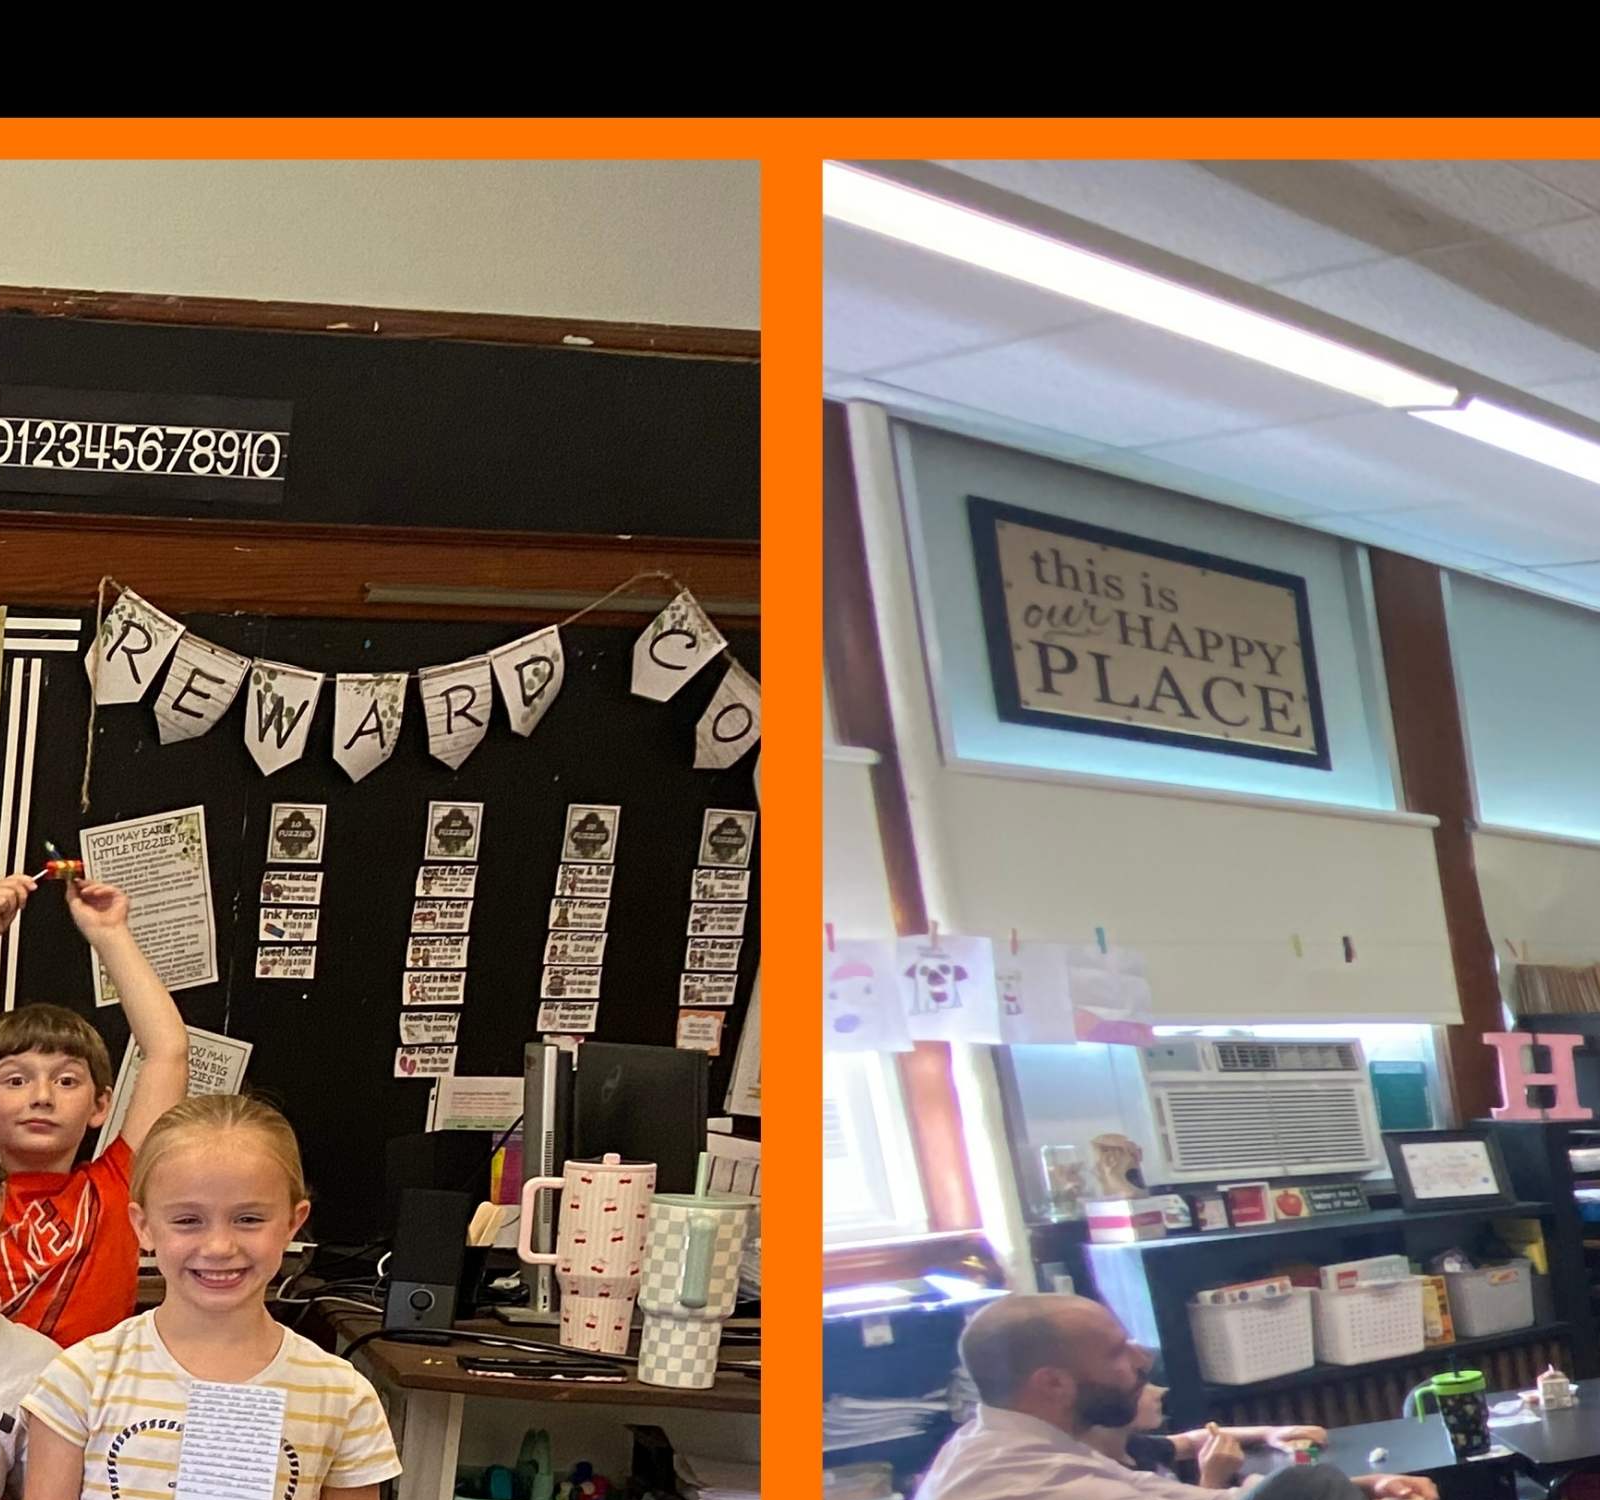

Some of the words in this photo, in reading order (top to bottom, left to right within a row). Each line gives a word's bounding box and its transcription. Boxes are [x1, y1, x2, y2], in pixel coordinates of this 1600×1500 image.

[1030, 548, 1126, 601] this
[1140, 571, 1179, 613] is
[1023, 600, 1111, 632] our
[1113, 609, 1286, 678] HAPPY
[106, 619, 555, 750] REWARD
[1029, 640, 1302, 738] PLACE
[90, 835, 114, 849] YOU
[116, 829, 141, 842] MAY
[263, 909, 282, 920] Ink
[285, 909, 318, 920] Pens!
[405, 1013, 433, 1023] Feeling
[189, 1045, 206, 1058] OU
[207, 1050, 232, 1064] MAY
[189, 1058, 209, 1071] ARN
[210, 1063, 229, 1077] BIG
[1482, 1033, 1592, 1120] H
